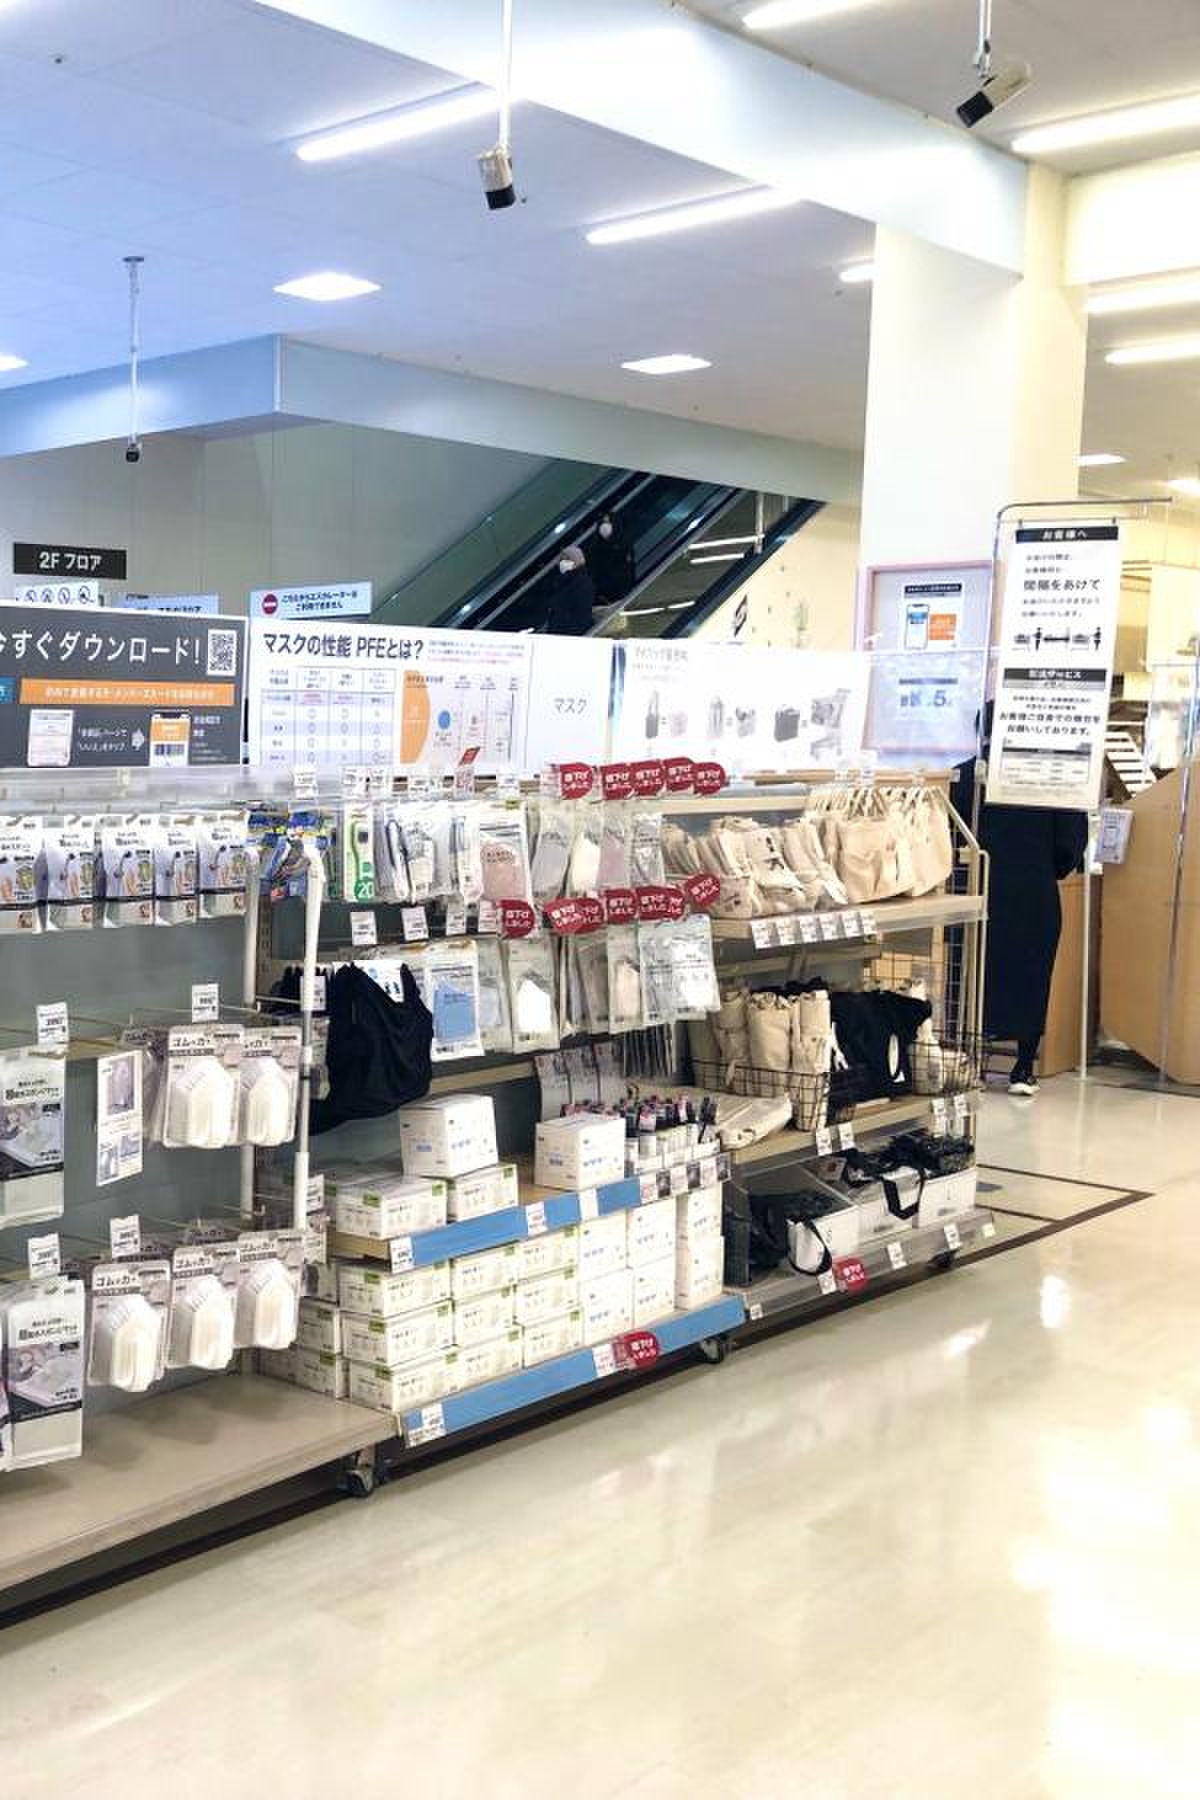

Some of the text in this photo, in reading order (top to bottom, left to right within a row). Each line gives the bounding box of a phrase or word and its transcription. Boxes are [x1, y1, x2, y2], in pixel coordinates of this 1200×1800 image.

[39, 551, 102, 570] 2F フロア
[263, 633, 351, 657] マスクの性能
[356, 636, 424, 660] PFEとは?
[553, 697, 587, 714] マスク
[358, 880, 373, 896] 20
